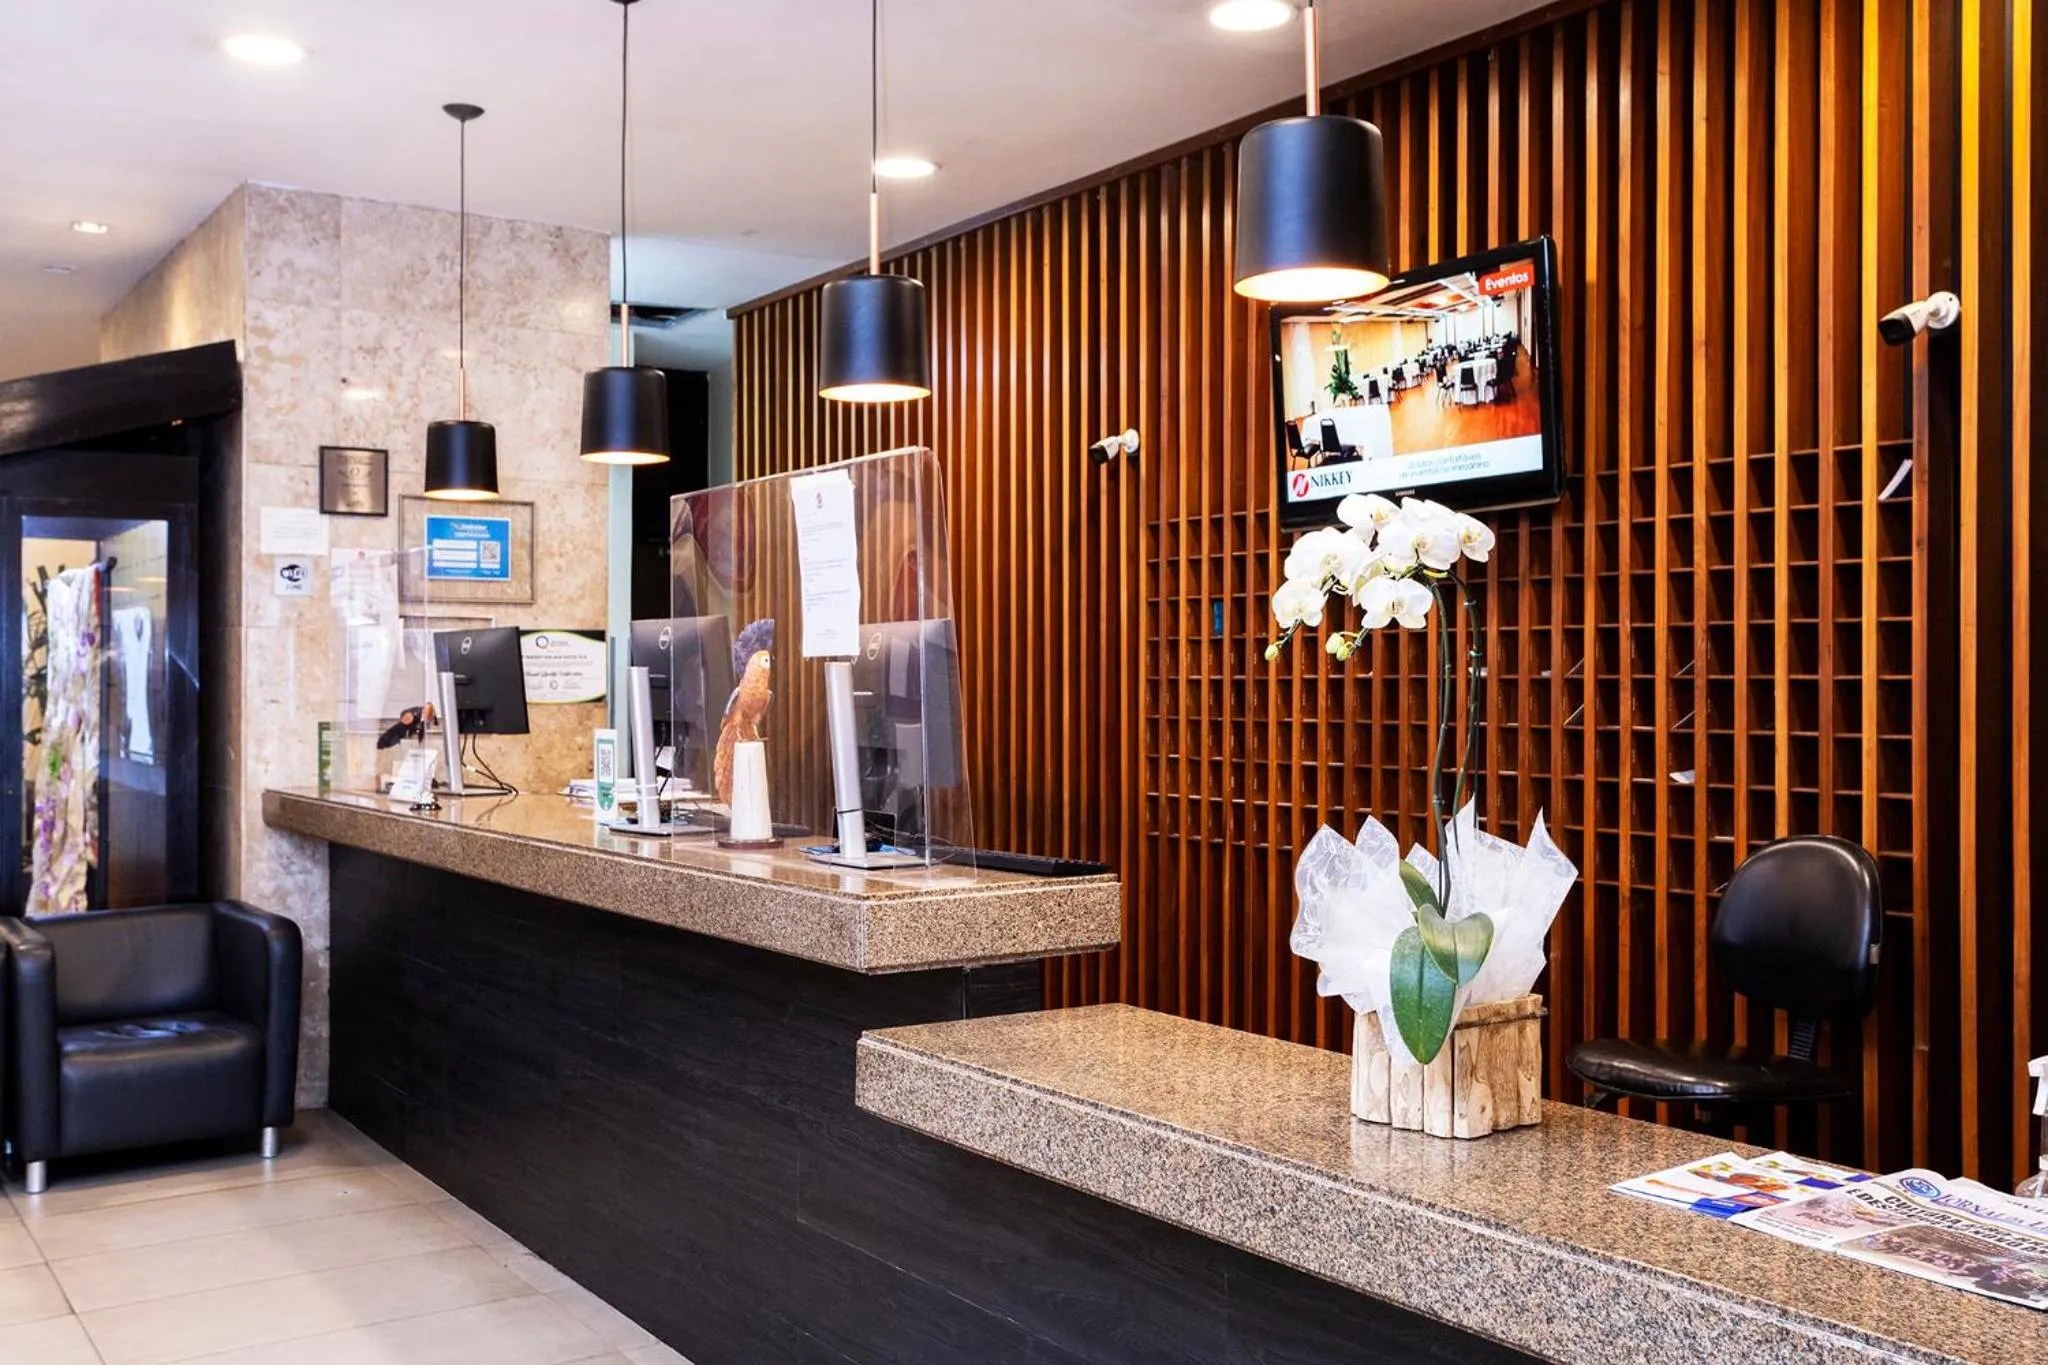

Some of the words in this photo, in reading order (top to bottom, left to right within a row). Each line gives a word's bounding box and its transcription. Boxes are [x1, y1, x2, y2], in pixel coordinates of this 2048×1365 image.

[1485, 272, 1529, 291] Eventos
[1311, 470, 1353, 488] NIKKEY
[1938, 1193, 2004, 1221] JORNAL
